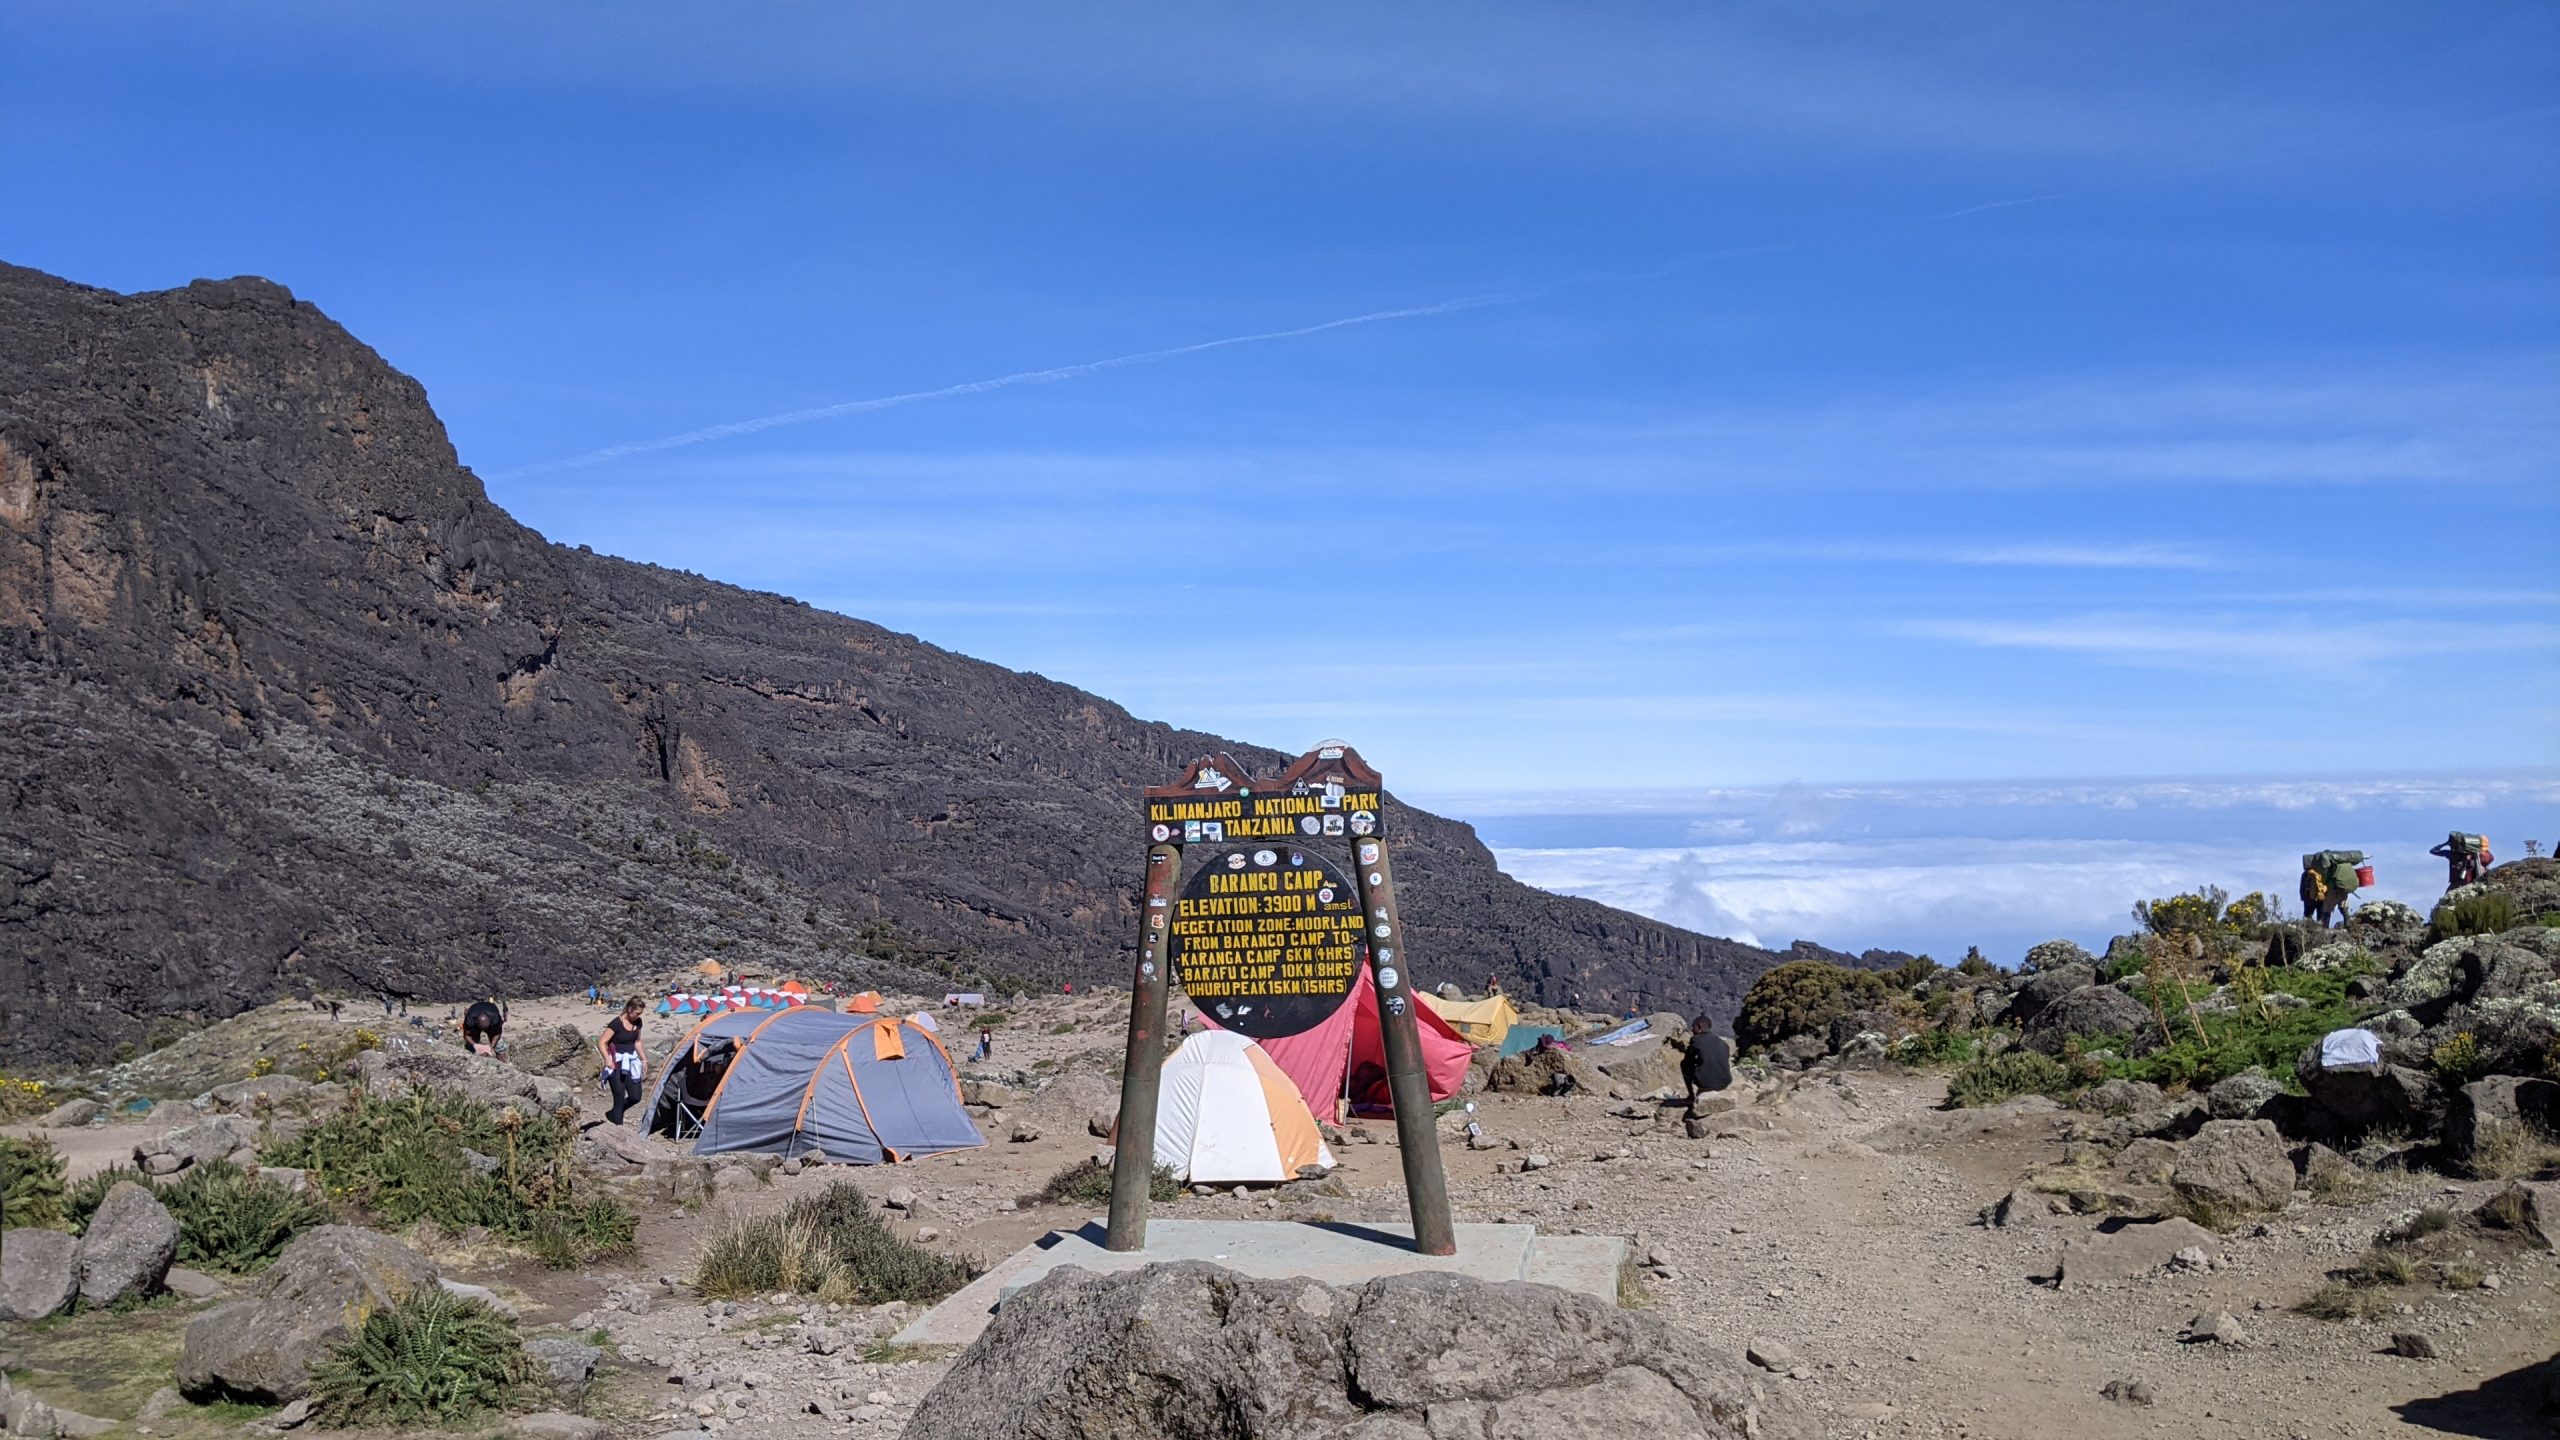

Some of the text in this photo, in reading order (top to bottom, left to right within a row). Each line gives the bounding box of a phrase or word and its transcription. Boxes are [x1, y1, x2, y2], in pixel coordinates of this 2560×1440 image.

[1151, 801, 1241, 821] KILIMANJARO
[1255, 798, 1325, 815] NATIONAL
[1343, 793, 1379, 811] PARK
[1225, 817, 1296, 836] TANZANIA
[1210, 870, 1323, 893] BARANCO CAMP
[1306, 894, 1316, 911] M
[1323, 898, 1354, 911] amsl
[1172, 919, 1253, 935] VEGETATION
[1184, 936, 1219, 950] FROM
[1224, 934, 1285, 949] BARANCO
[1290, 932, 1325, 946] CAMP
[1247, 950, 1281, 963] CAMP
[1286, 949, 1312, 961] 6KM
[1314, 945, 1356, 962] (4HRS)
[1240, 966, 1275, 980] CAMP
[1281, 965, 1313, 978] 10KM
[1314, 961, 1356, 977] (8HRS)
[1232, 981, 1267, 995] PEAK
